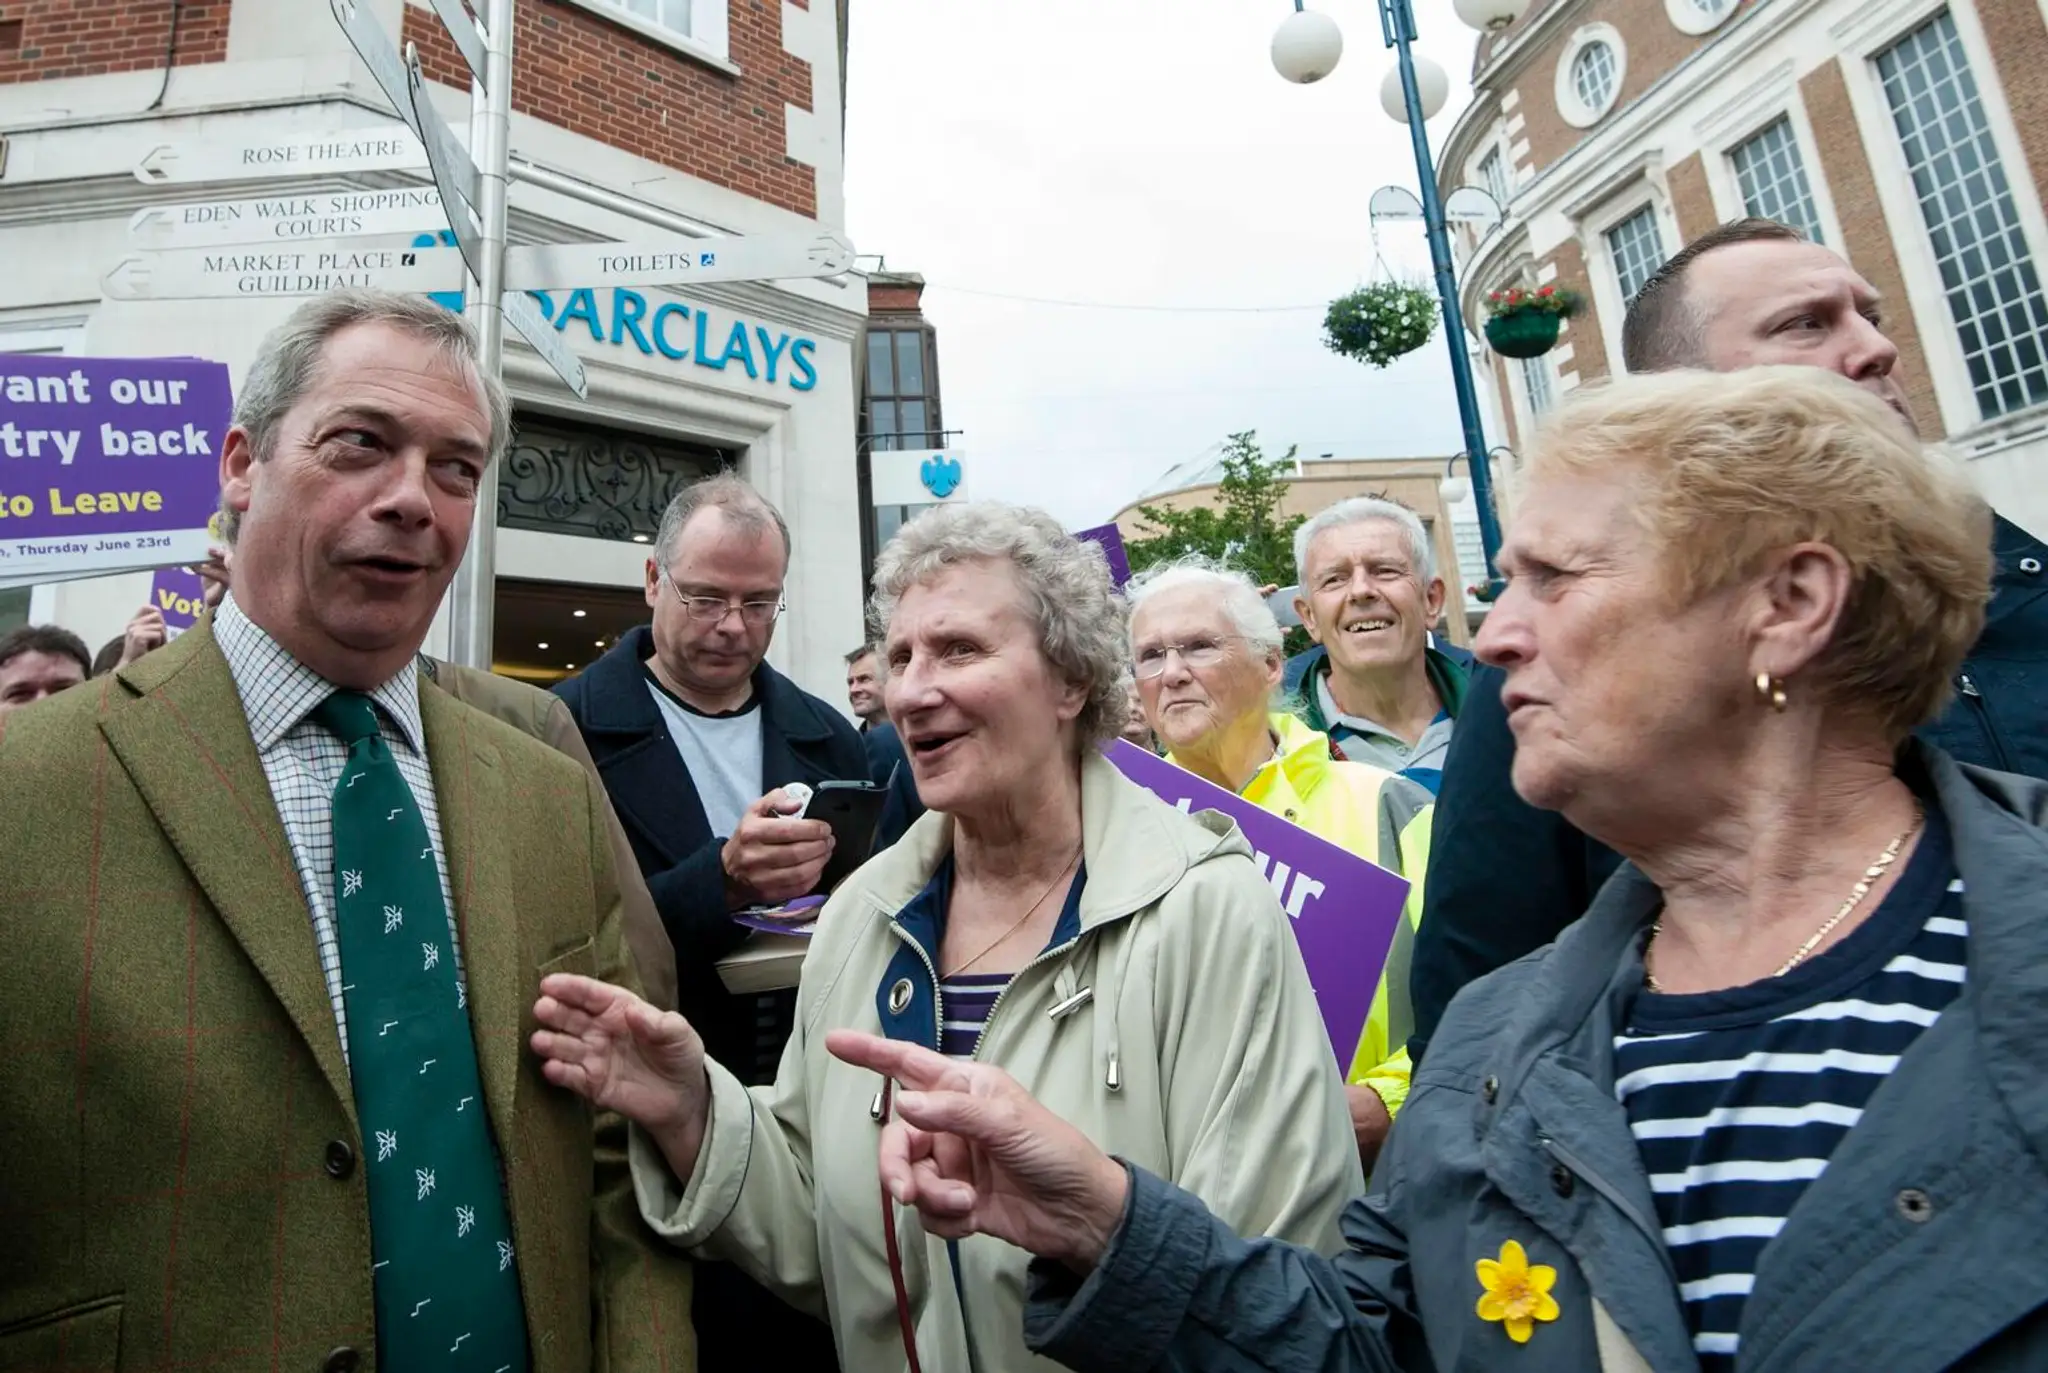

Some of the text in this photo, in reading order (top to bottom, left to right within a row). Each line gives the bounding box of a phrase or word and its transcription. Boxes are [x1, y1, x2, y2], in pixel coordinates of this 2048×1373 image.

[243, 140, 404, 165] ROSE THEATRE
[184, 191, 440, 224] EDEN WALK SHOPPING
[275, 217, 362, 238] COURTS
[204, 252, 393, 273] MARKET PLACE
[599, 253, 691, 275] TOILETS
[238, 274, 376, 292] GUILDHALL
[0, 369, 188, 405] ant our
[100, 422, 212, 456] back
[49, 488, 163, 516] Leave
[16, 542, 89, 557] Thursday
[95, 540, 131, 551] June
[136, 536, 171, 548] 23rd
